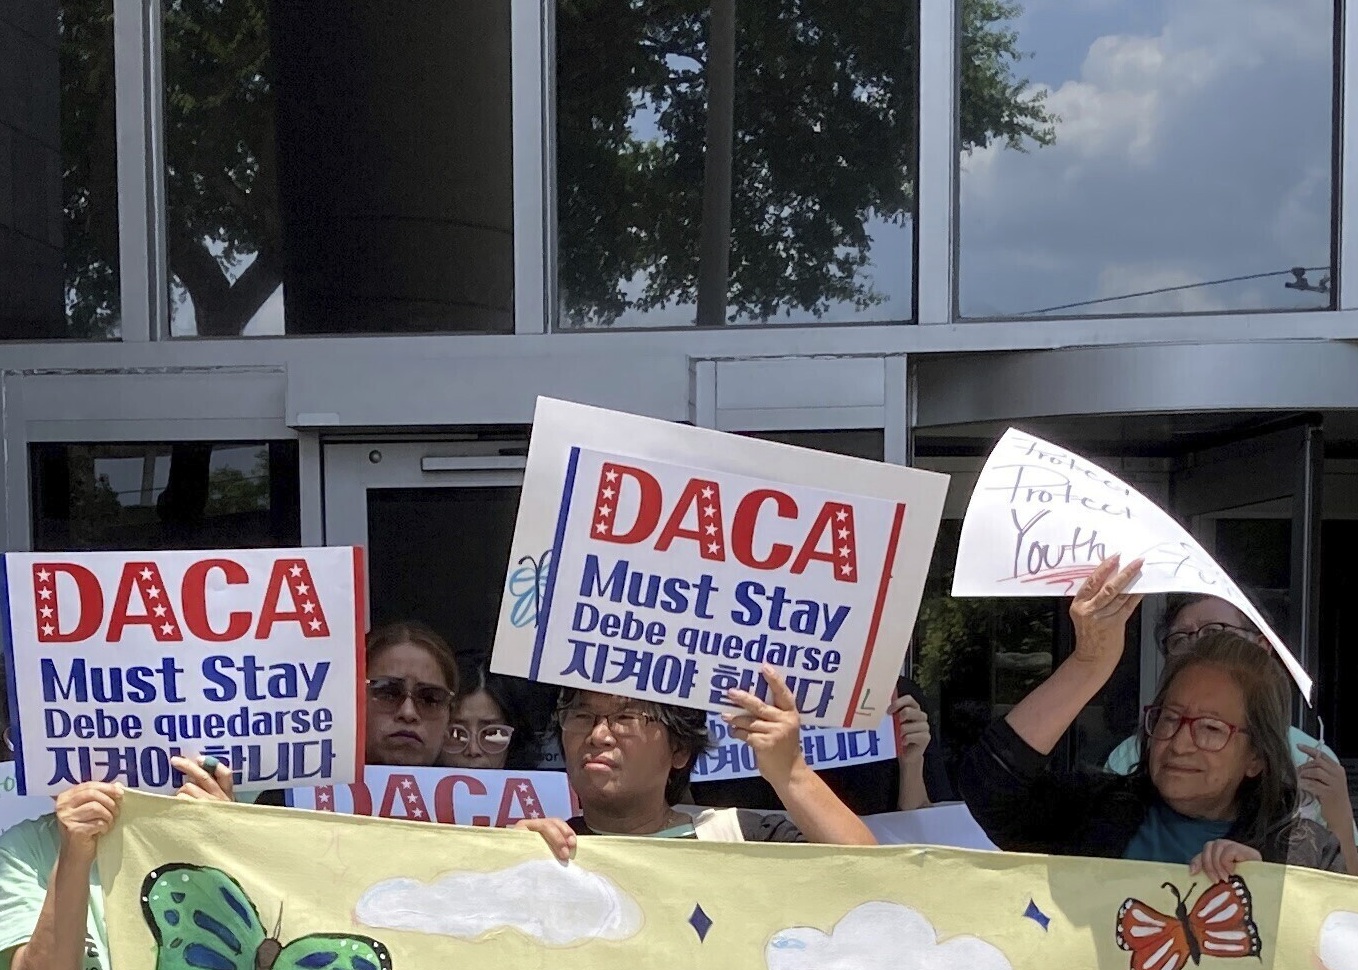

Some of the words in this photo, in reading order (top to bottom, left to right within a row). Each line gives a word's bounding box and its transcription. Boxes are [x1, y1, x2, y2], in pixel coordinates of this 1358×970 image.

[590, 462, 858, 583] DACA
[1010, 508, 1106, 579] Youth
[32, 559, 330, 642] DACA
[579, 554, 718, 619] Must
[731, 581, 851, 641] Stay
[560, 639, 699, 699] 지켜야
[572, 602, 666, 645] Debe
[678, 626, 841, 673] quedarse
[40, 657, 186, 703] Must
[202, 655, 331, 702] Stay
[44, 708, 142, 739] Debe
[154, 707, 333, 742] quedarse
